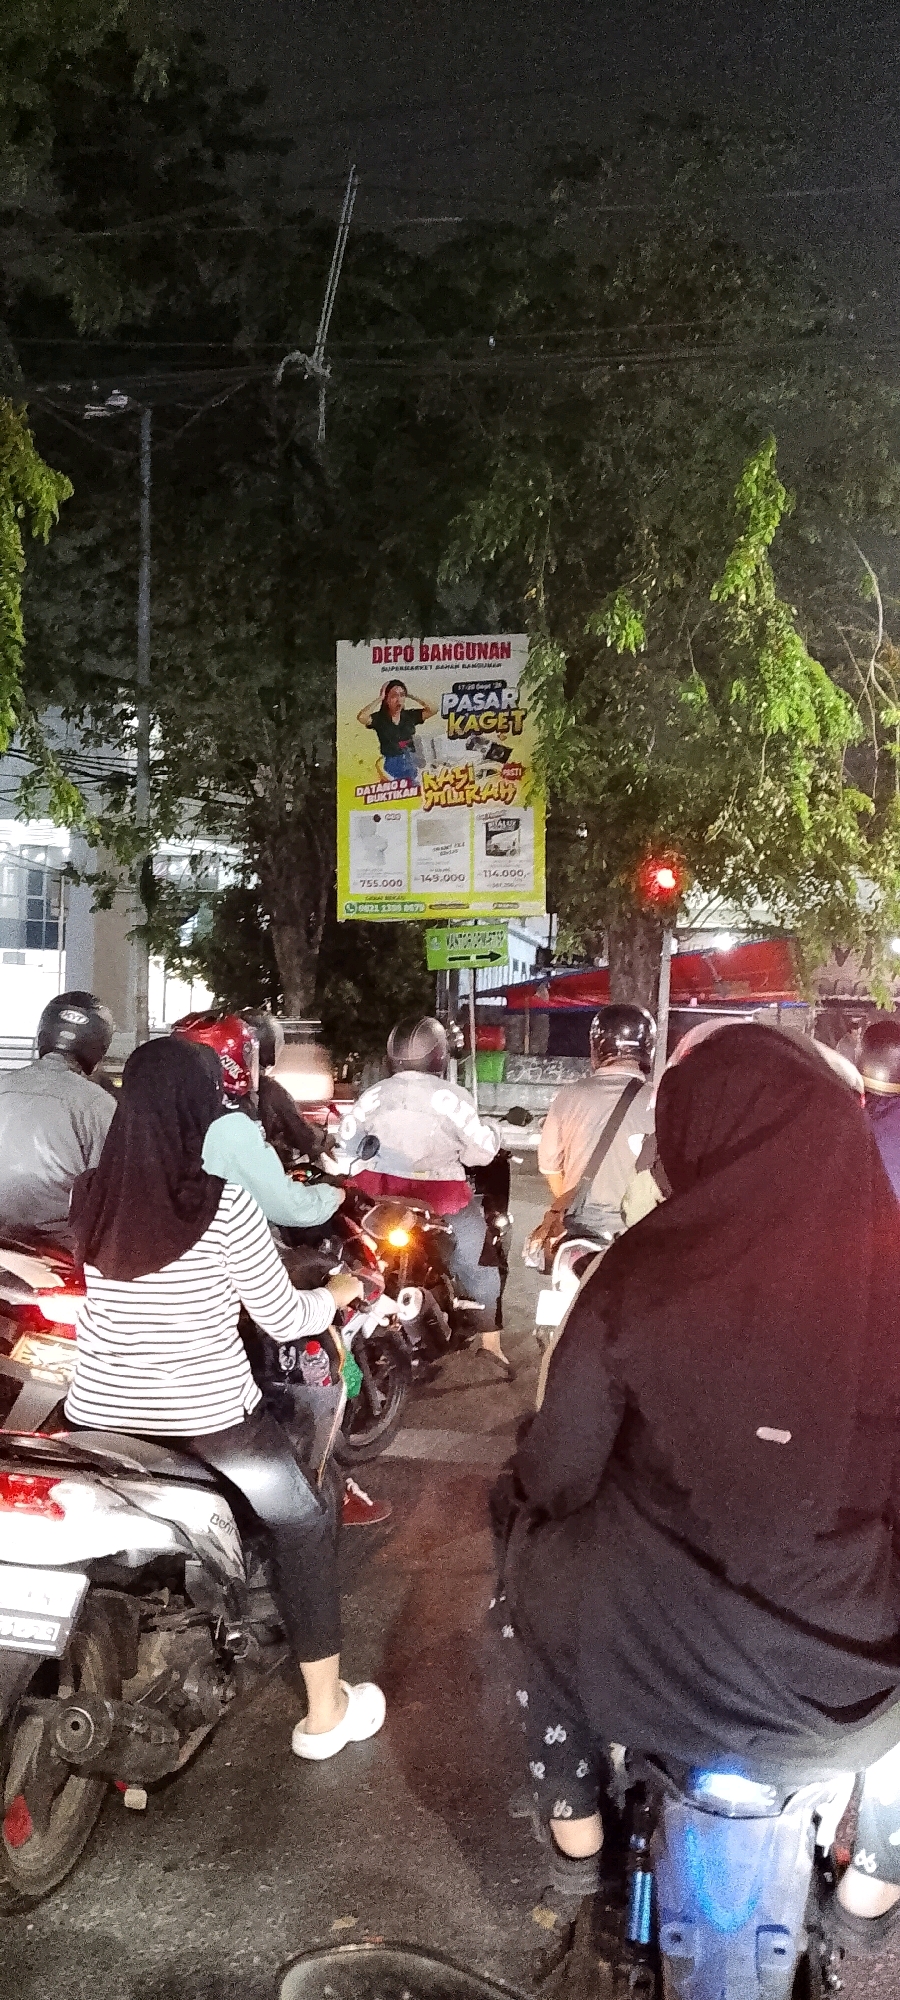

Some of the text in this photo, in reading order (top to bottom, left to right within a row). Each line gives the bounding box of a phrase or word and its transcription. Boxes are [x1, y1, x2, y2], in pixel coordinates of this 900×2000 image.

[372, 641, 512, 664] DEPO BANGUNAN
[442, 687, 519, 716] PASAR
[448, 709, 526, 738] KAGET
[356, 780, 399, 797] DATANG
[422, 762, 475, 791] KASI
[366, 786, 418, 805] BUKTIKAN
[422, 780, 518, 812] MURAH
[360, 879, 403, 888] 755.000
[219, 1053, 244, 1080] NHK
